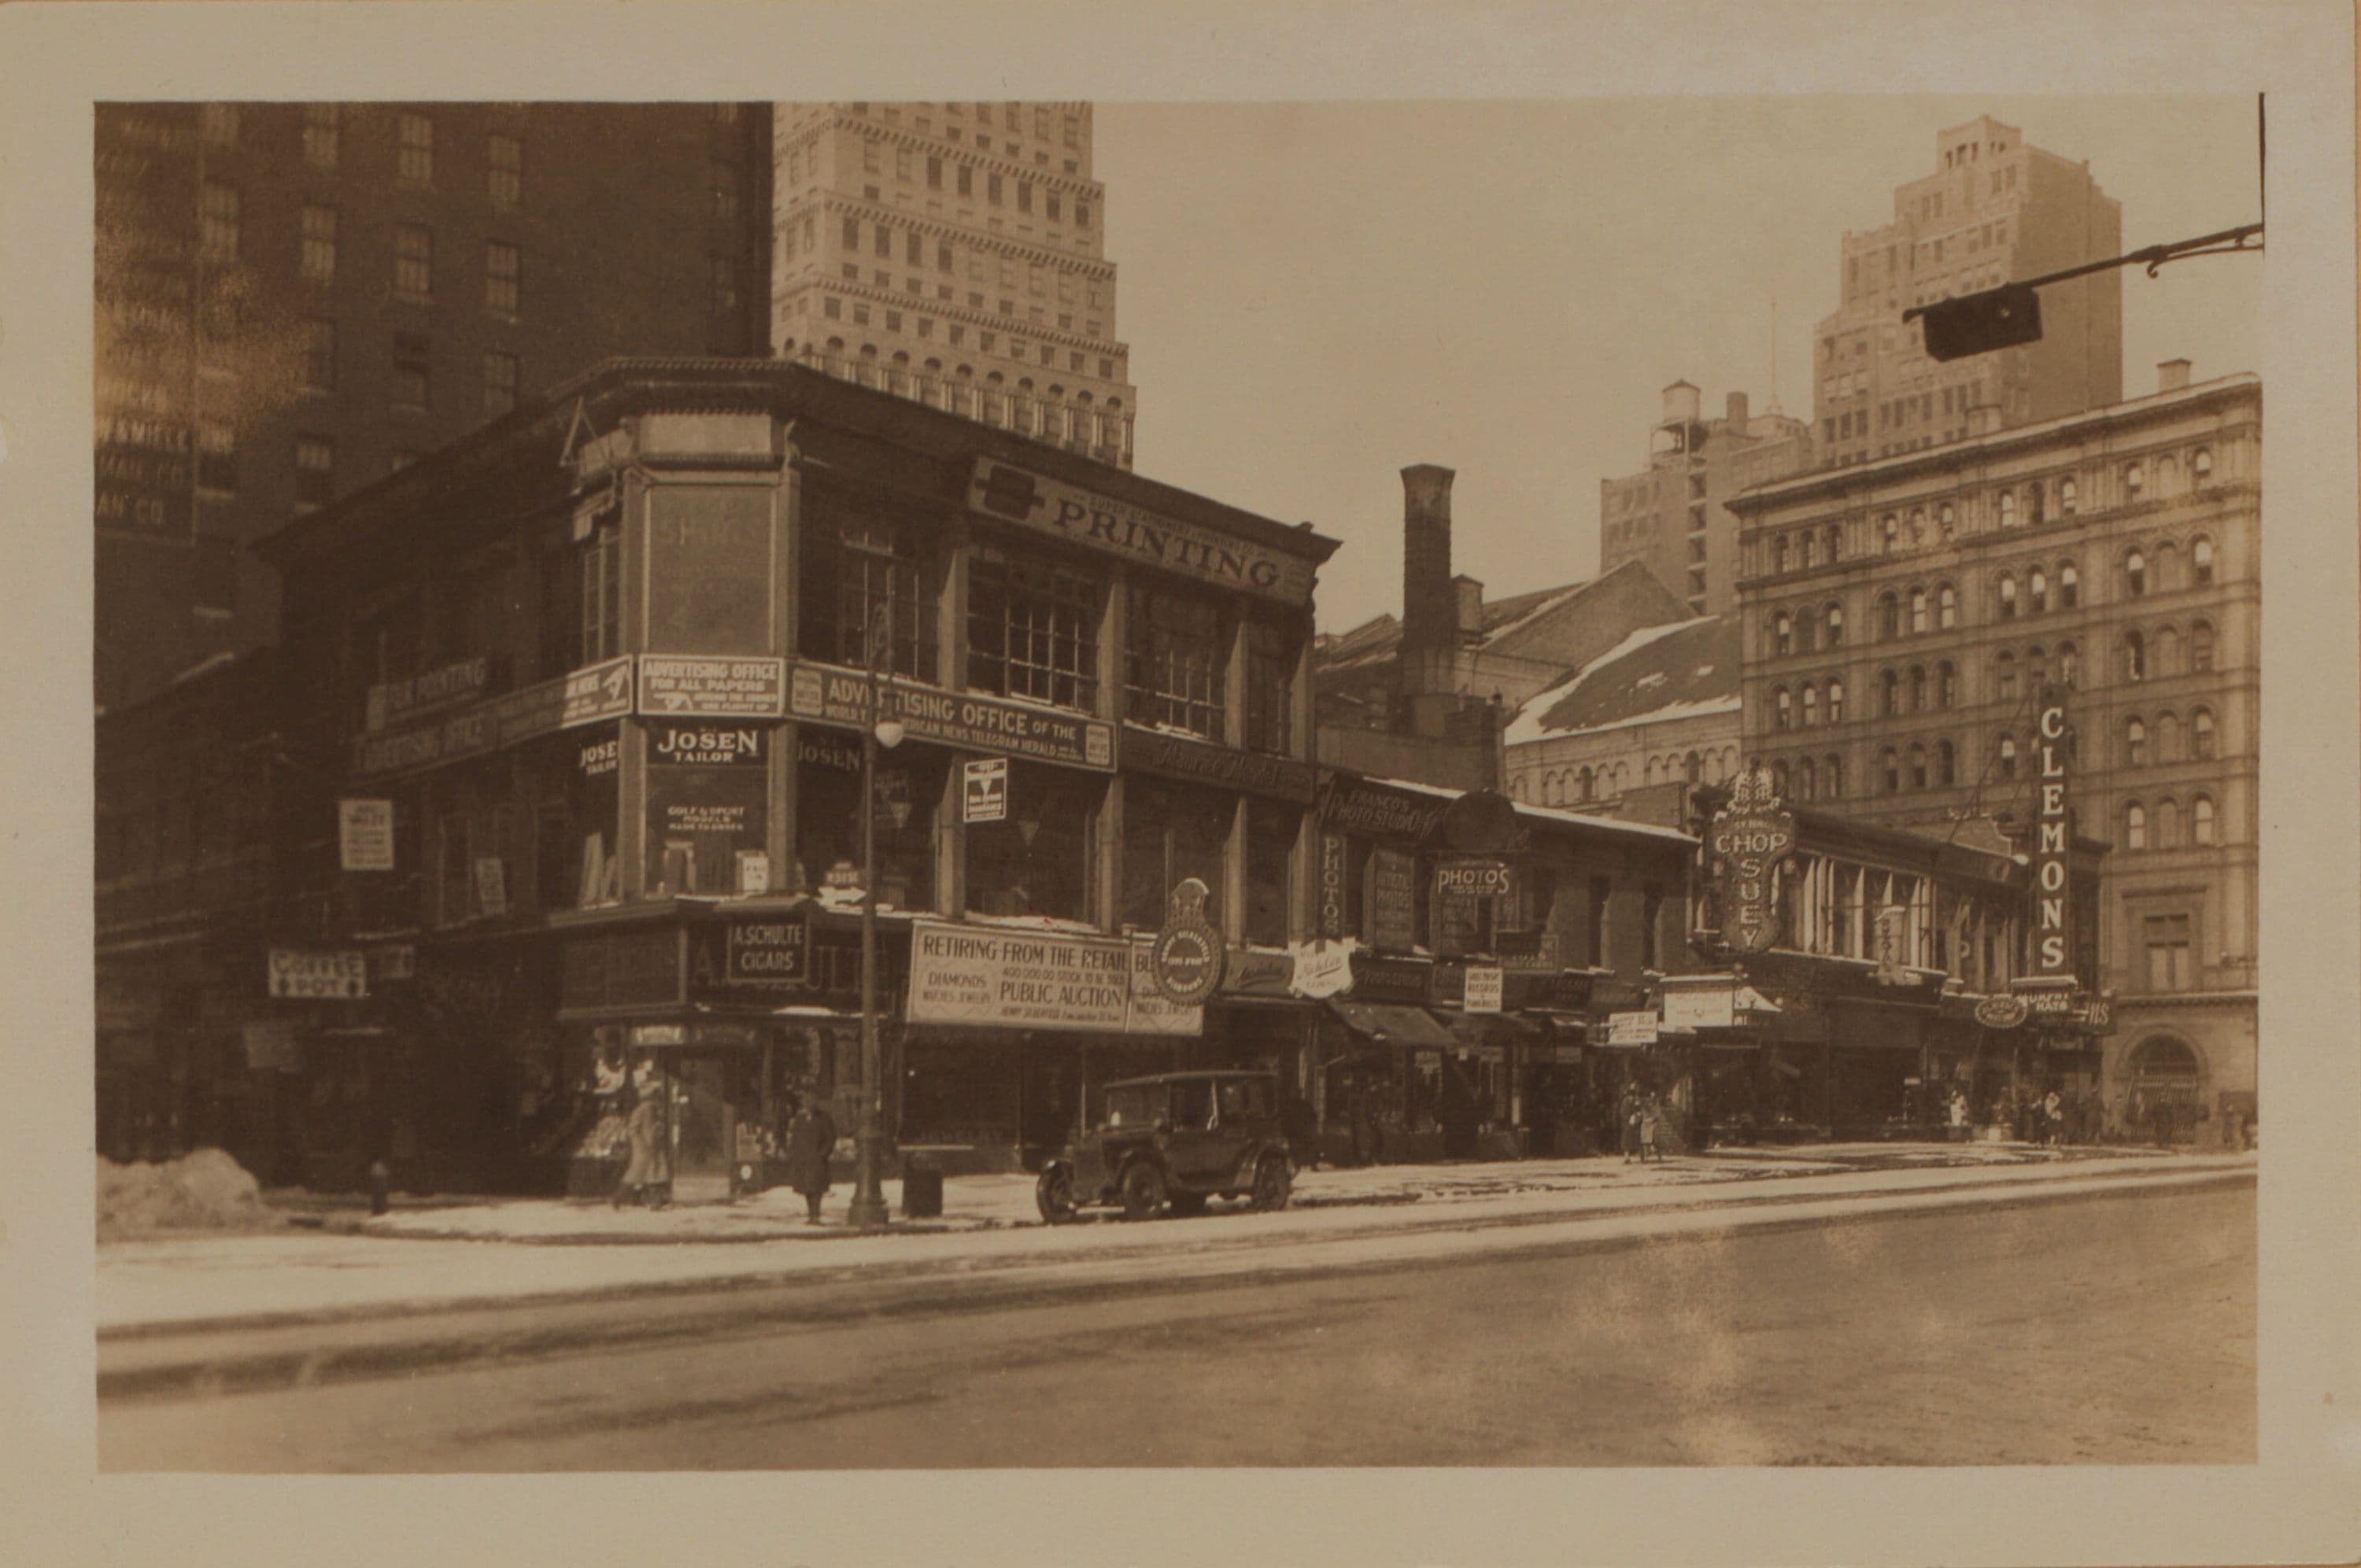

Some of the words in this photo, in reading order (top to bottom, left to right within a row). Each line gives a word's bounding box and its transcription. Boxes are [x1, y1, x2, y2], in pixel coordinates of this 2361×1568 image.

[1053, 497, 1280, 588] PRINTING
[644, 661, 729, 680] ADVERTISING
[732, 665, 778, 681] OFFICE
[651, 678, 675, 690] FOR
[678, 679, 702, 691] ALL
[706, 680, 766, 692] PAPERS
[962, 703, 1028, 736] OFFICE
[1033, 721, 1047, 734] OF
[1052, 724, 1077, 740] THE
[657, 729, 759, 753] JOSEN
[970, 730, 1019, 750] TELEGRAM
[1021, 740, 1057, 757] HERALD
[674, 751, 733, 762] TAILOR
[1715, 832, 1787, 854] CHOP
[2040, 707, 2065, 969] CLEMONS
[1323, 837, 1339, 935] PHOTOS
[1438, 869, 1509, 895] PHOTOS
[1740, 858, 1761, 947] SUEY
[741, 950, 794, 971] CIGARS
[923, 935, 996, 960] RETIRING
[1003, 942, 1044, 965] FROM
[1051, 946, 1077, 968] THE
[1081, 950, 1127, 972] RETAIL
[929, 971, 987, 988] DIAMONDS
[999, 982, 1053, 1004] PUBLIC
[1058, 985, 1122, 1007] AUCTION
